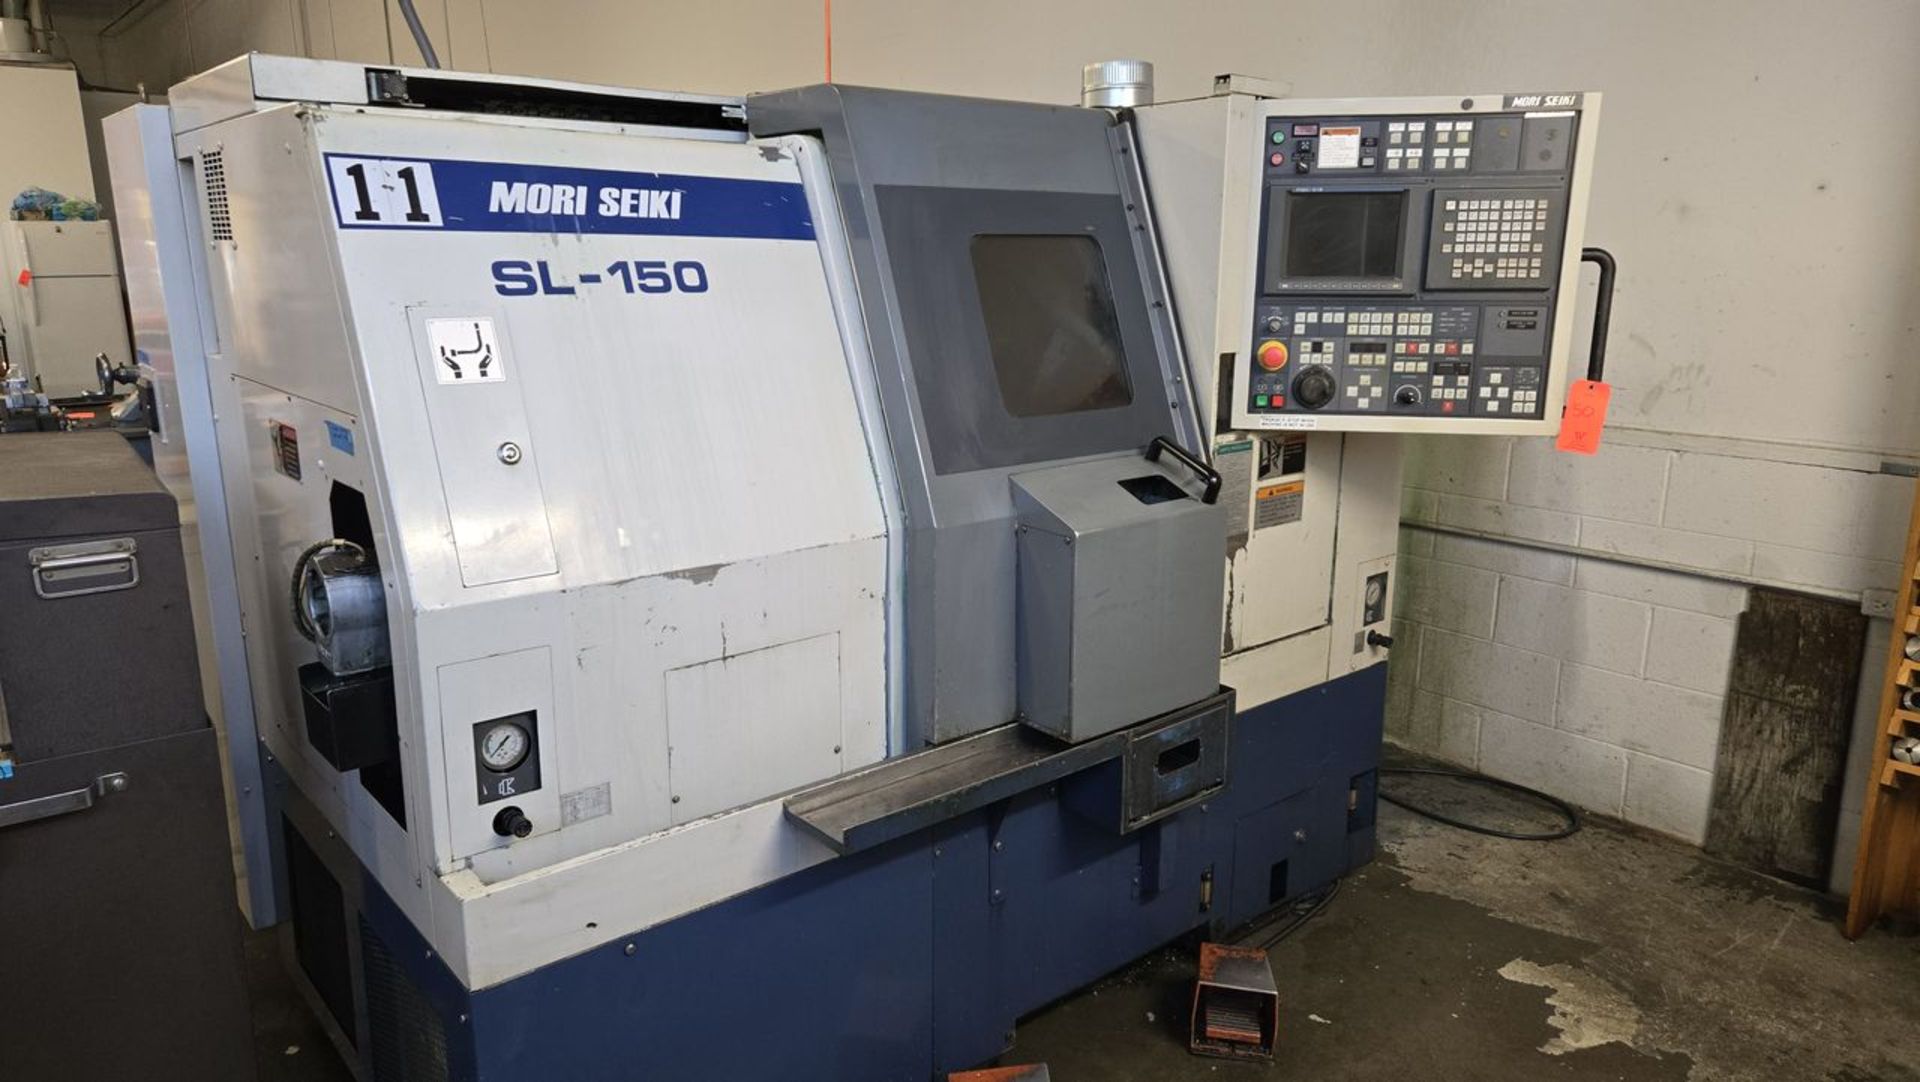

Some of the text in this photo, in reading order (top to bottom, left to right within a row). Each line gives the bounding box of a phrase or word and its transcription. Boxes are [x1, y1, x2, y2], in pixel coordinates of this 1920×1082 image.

[1511, 94, 1576, 108] MORI SEIKI
[489, 181, 682, 219] MORI SEIKI
[491, 260, 709, 296] SL-150
